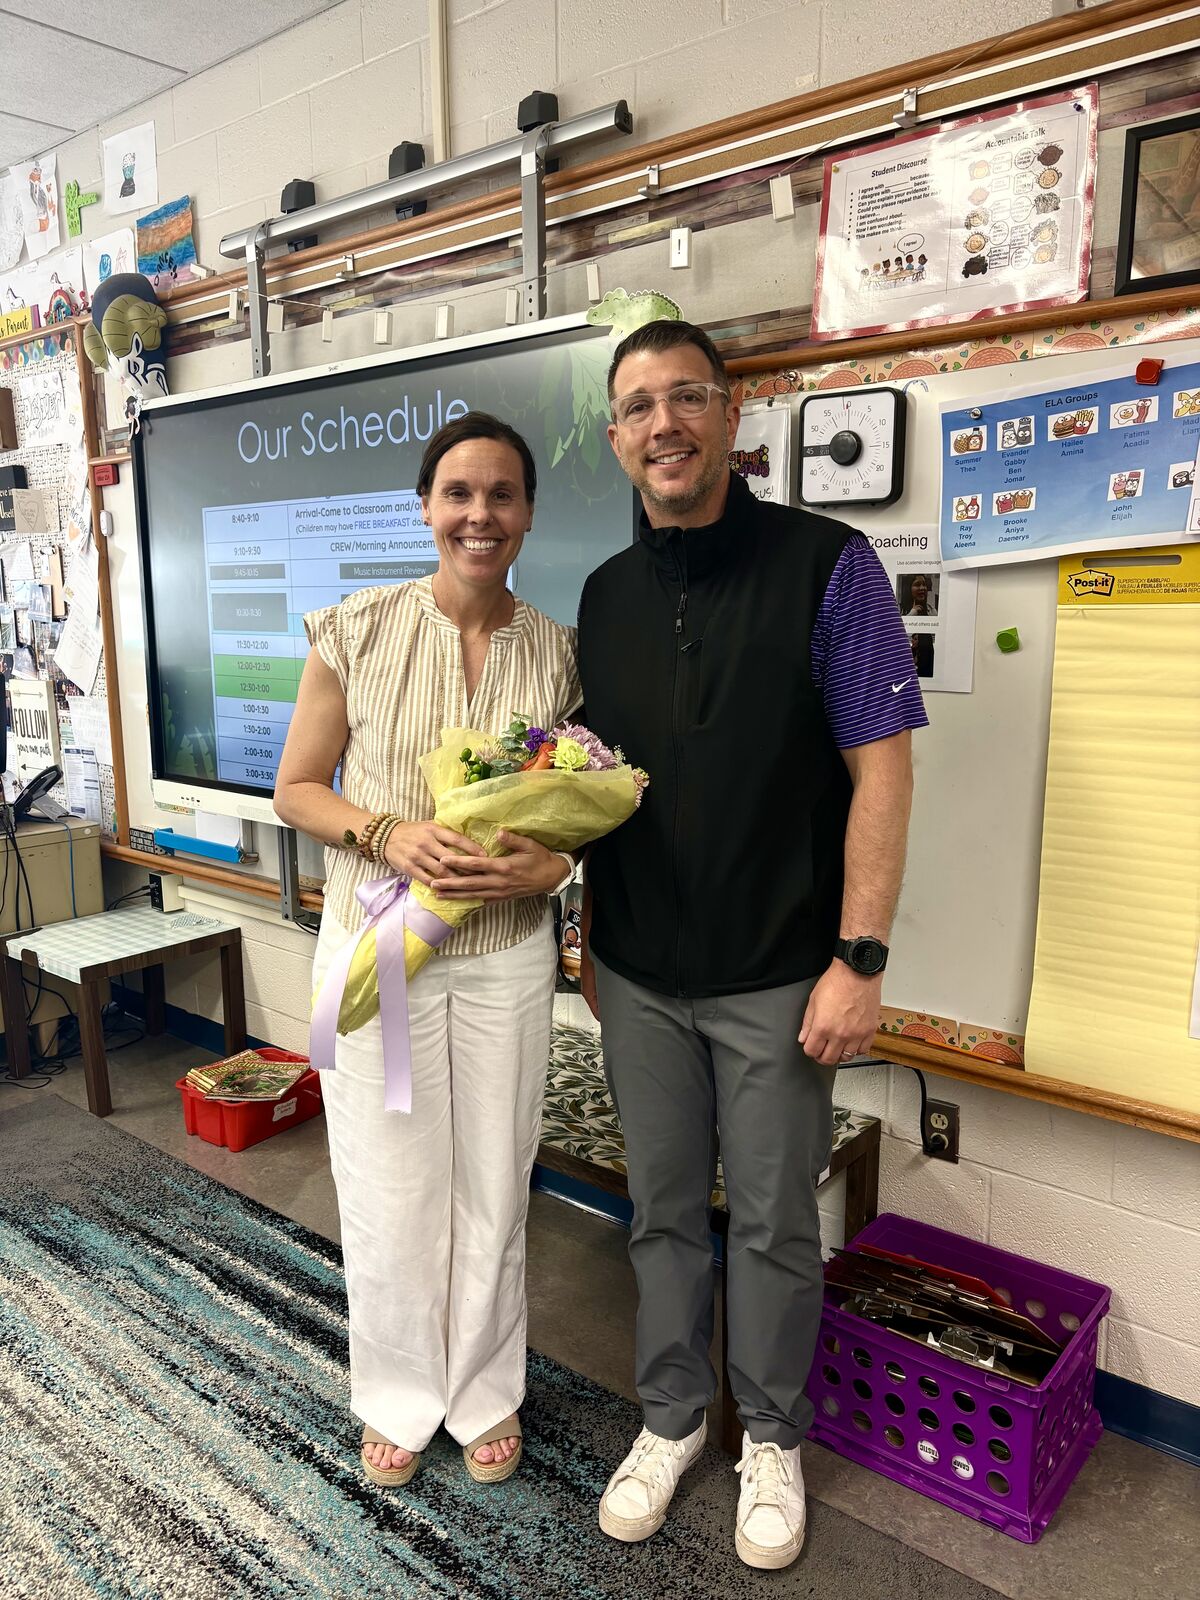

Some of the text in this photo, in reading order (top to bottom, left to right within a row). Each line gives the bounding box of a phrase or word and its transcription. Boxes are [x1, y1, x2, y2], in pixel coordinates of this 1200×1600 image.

[984, 127, 1046, 149] Accountable Talk
[871, 158, 928, 178] Student Discourse
[861, 192, 880, 200] disagree
[877, 195, 894, 203] explain
[906, 186, 930, 195] evidence?
[857, 206, 871, 214] Could
[881, 201, 896, 209] please
[897, 196, 912, 204] repeat
[867, 215, 888, 224] confused
[1045, 392, 1098, 408] ELA Groups
[823, 409, 831, 417] 55
[238, 389, 469, 464] Our Schedule
[879, 418, 886, 426] 10
[1123, 430, 1150, 440] Fatima
[1061, 438, 1084, 448] Hailee
[1123, 439, 1150, 449] Acadia
[1001, 449, 1030, 460] Evander
[1061, 447, 1085, 458] Amina
[954, 457, 982, 467] Summer
[1004, 458, 1027, 468] Gabby
[876, 464, 884, 472] 20
[960, 465, 976, 474] Thea
[1008, 467, 1022, 475] Ben
[1004, 475, 1026, 484] Jomar
[862, 481, 870, 489] 25
[754, 485, 774, 499] CUS!
[295, 507, 341, 519] Arrival-Come
[343, 506, 351, 516] to
[353, 503, 393, 515] Classroom
[1113, 504, 1132, 513] John
[231, 512, 260, 523] 8:40-9:10
[1003, 517, 1028, 527] Brooke
[1111, 512, 1132, 522] Elijah
[296, 523, 323, 534] (Children
[325, 523, 338, 533] may
[338, 522, 354, 531] have
[355, 520, 372, 529] FREE
[373, 518, 411, 529] BREAKFAST
[960, 525, 972, 534] Ray
[1005, 526, 1024, 535] Aniya
[867, 534, 928, 550] Coaching
[959, 533, 972, 542] Troy
[998, 534, 1029, 544] Daenerys
[330, 540, 387, 552] CREW/Morning
[954, 541, 976, 550] Aleena
[233, 546, 262, 556] 9:10-9:30
[354, 564, 427, 576] Music Instrument Review
[1074, 578, 1110, 588] Post-it
[236, 640, 269, 650] 11:30-12:00
[237, 661, 271, 671] 12:00-12:30
[239, 682, 270, 693] 12:30-1:00
[243, 704, 269, 715] 1:00-1:30
[14, 708, 49, 740] FOLLOW
[244, 724, 271, 736] 1:30-2:00
[17, 744, 29, 756] your
[30, 745, 39, 754] own
[40, 742, 51, 758] path
[244, 746, 273, 759] 2:00-3:00
[245, 768, 274, 781] 3:00-3:30
